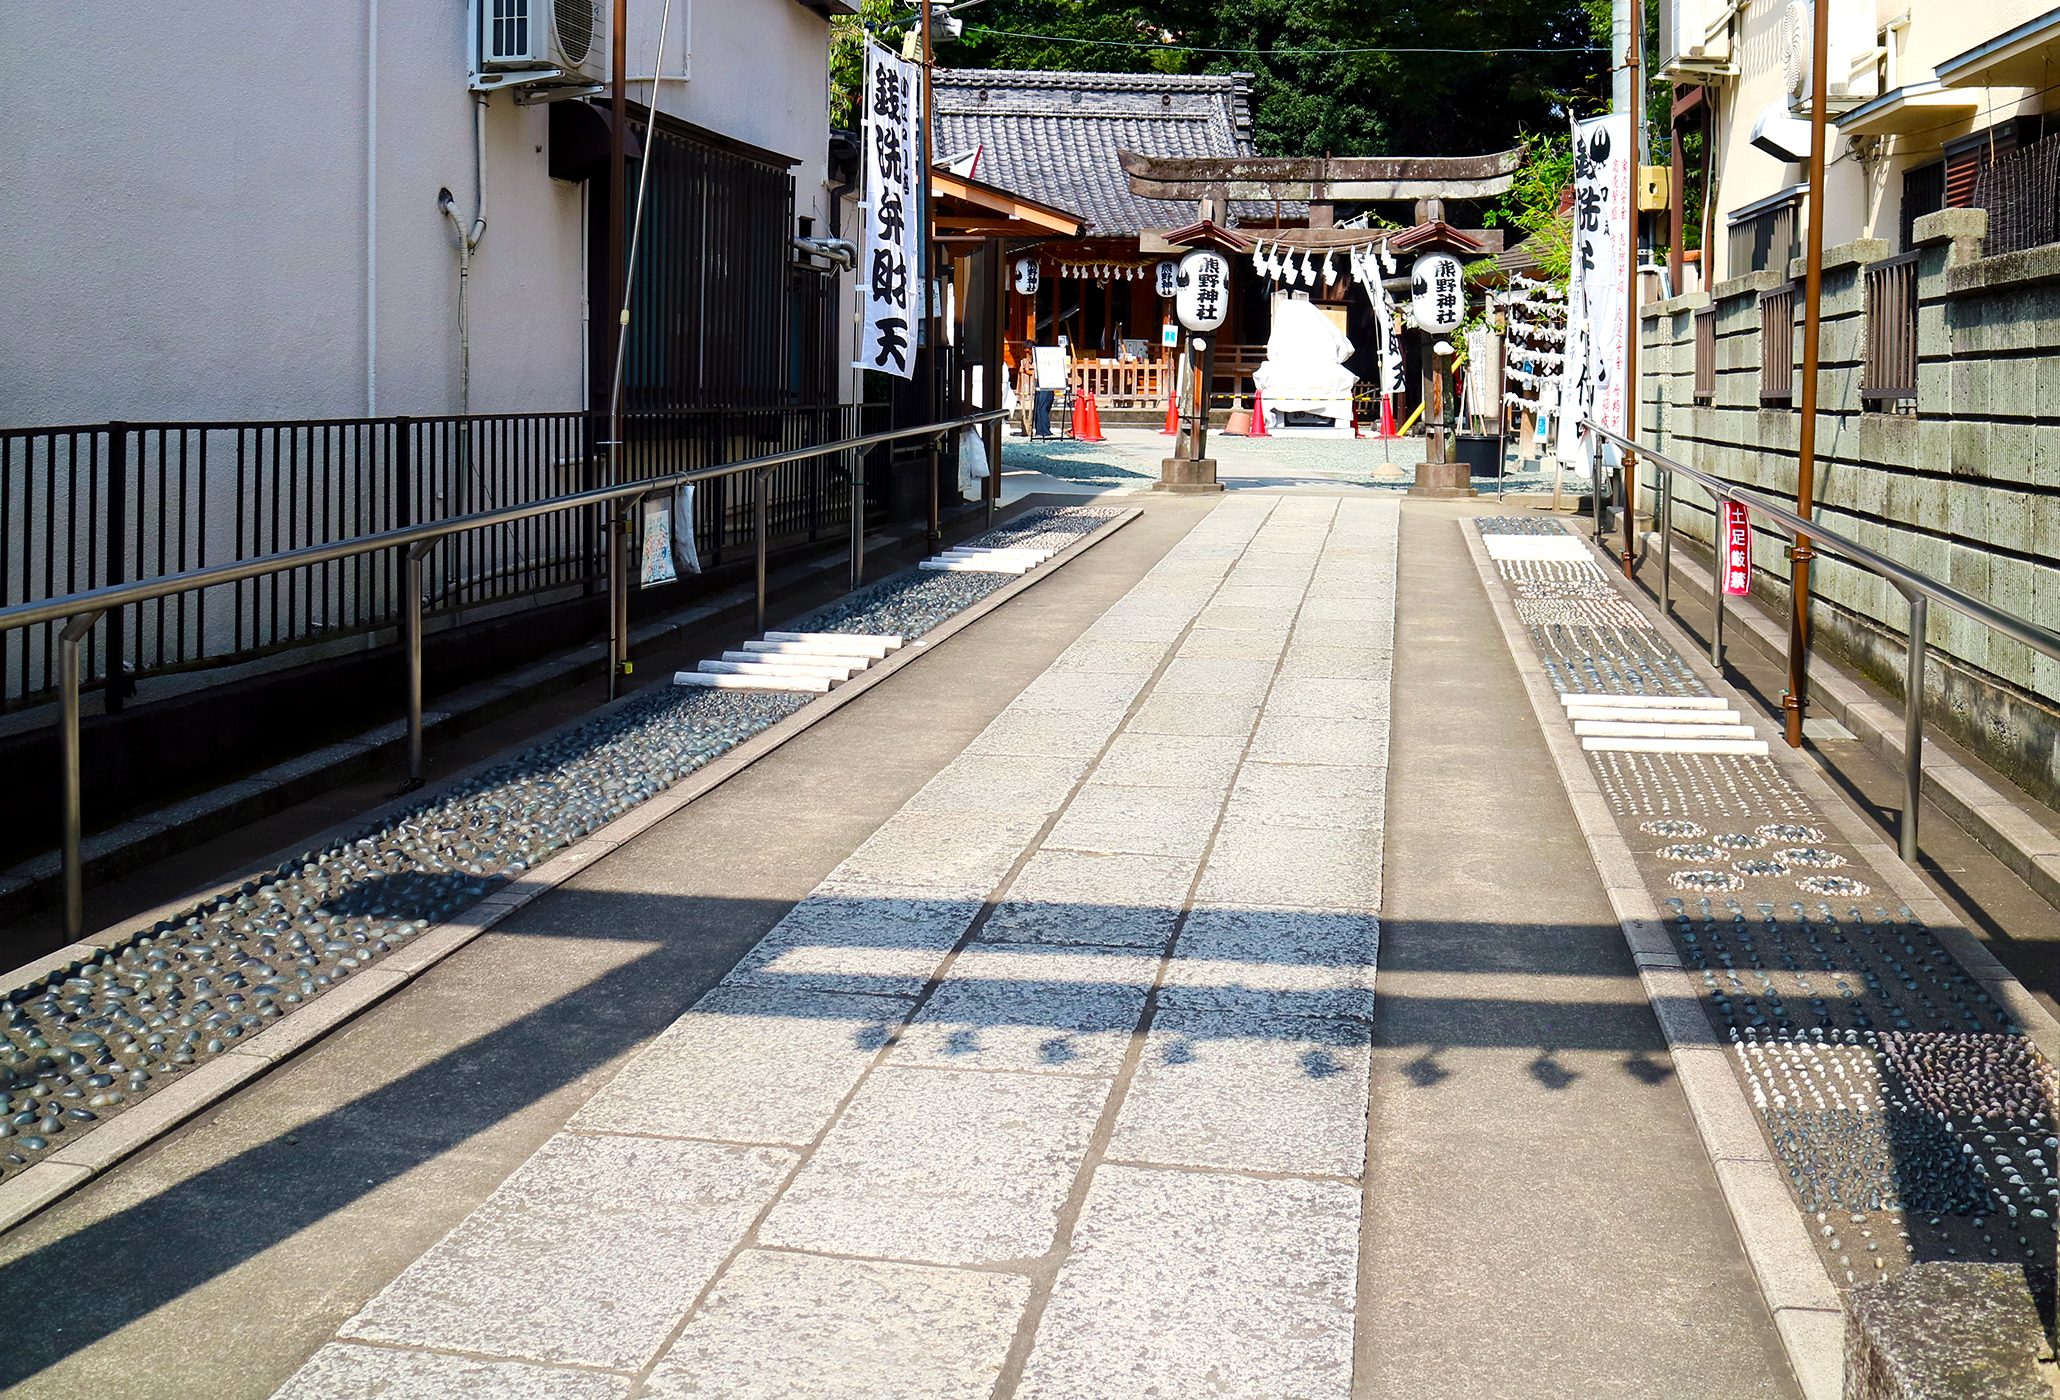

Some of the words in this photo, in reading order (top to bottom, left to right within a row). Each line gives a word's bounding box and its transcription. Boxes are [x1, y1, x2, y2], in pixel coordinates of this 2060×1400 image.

[872, 61, 908, 373] 銭洗弁財天
[1620, 158, 1628, 220] 家内安全
[1026, 259, 1038, 292] 熊野神社
[1161, 262, 1173, 296] 熊野神社
[1196, 257, 1220, 321] 熊野神社
[1434, 260, 1457, 325] 熊野神社
[1616, 233, 1626, 295] 厄除祈願
[1471, 333, 1486, 397] 熊野神社
[1615, 308, 1624, 370] 交通安全
[1611, 383, 1622, 434] 合格祈
[1731, 507, 1746, 589] 土足厳禁
